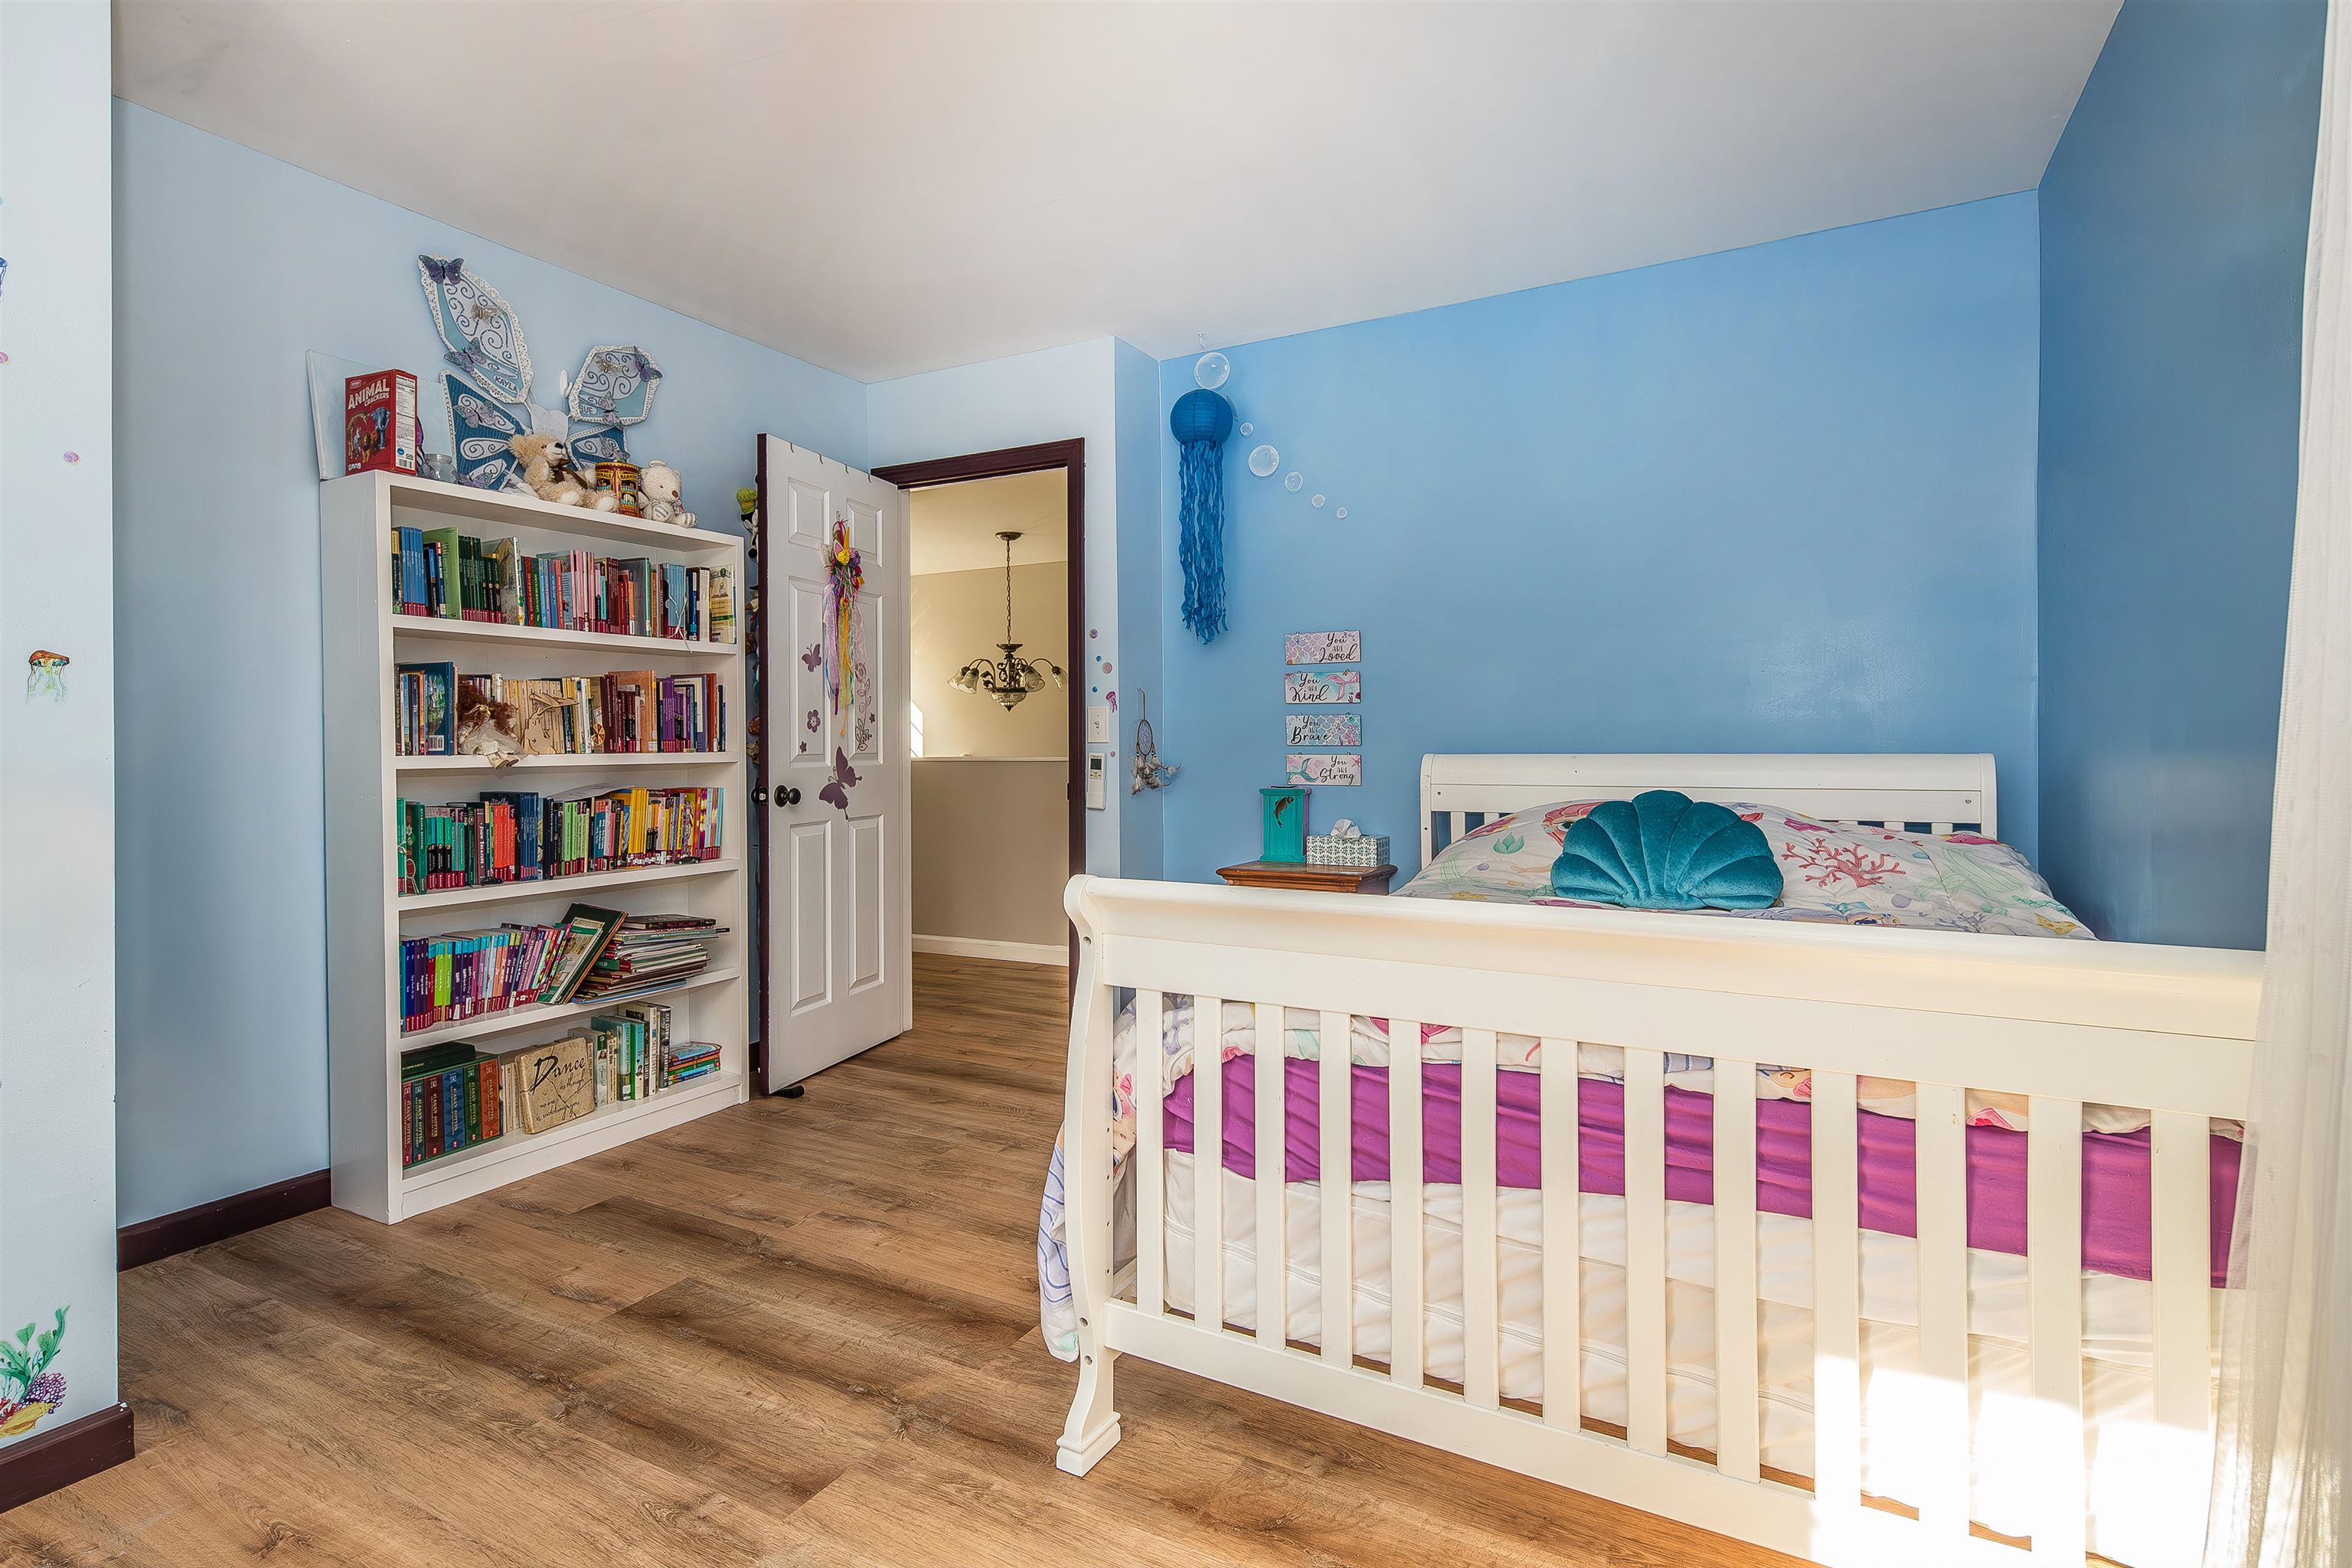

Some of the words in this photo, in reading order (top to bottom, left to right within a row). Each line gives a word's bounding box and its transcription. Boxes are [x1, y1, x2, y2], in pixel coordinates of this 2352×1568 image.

[495, 376, 518, 393] KAYLA
[348, 379, 390, 410] ANIMAL
[364, 393, 390, 407] CRACKERS
[579, 404, 593, 413] SUE
[1326, 632, 1348, 647] You
[1319, 643, 1357, 662] Loved
[1299, 673, 1320, 687] You
[1289, 684, 1330, 702] Kind
[1302, 715, 1321, 729] You
[1291, 726, 1330, 744] Brave
[1331, 756, 1348, 767] You
[1319, 768, 1356, 785] Strong
[530, 1055, 586, 1096] Dance
[543, 1105, 567, 1121] watching
